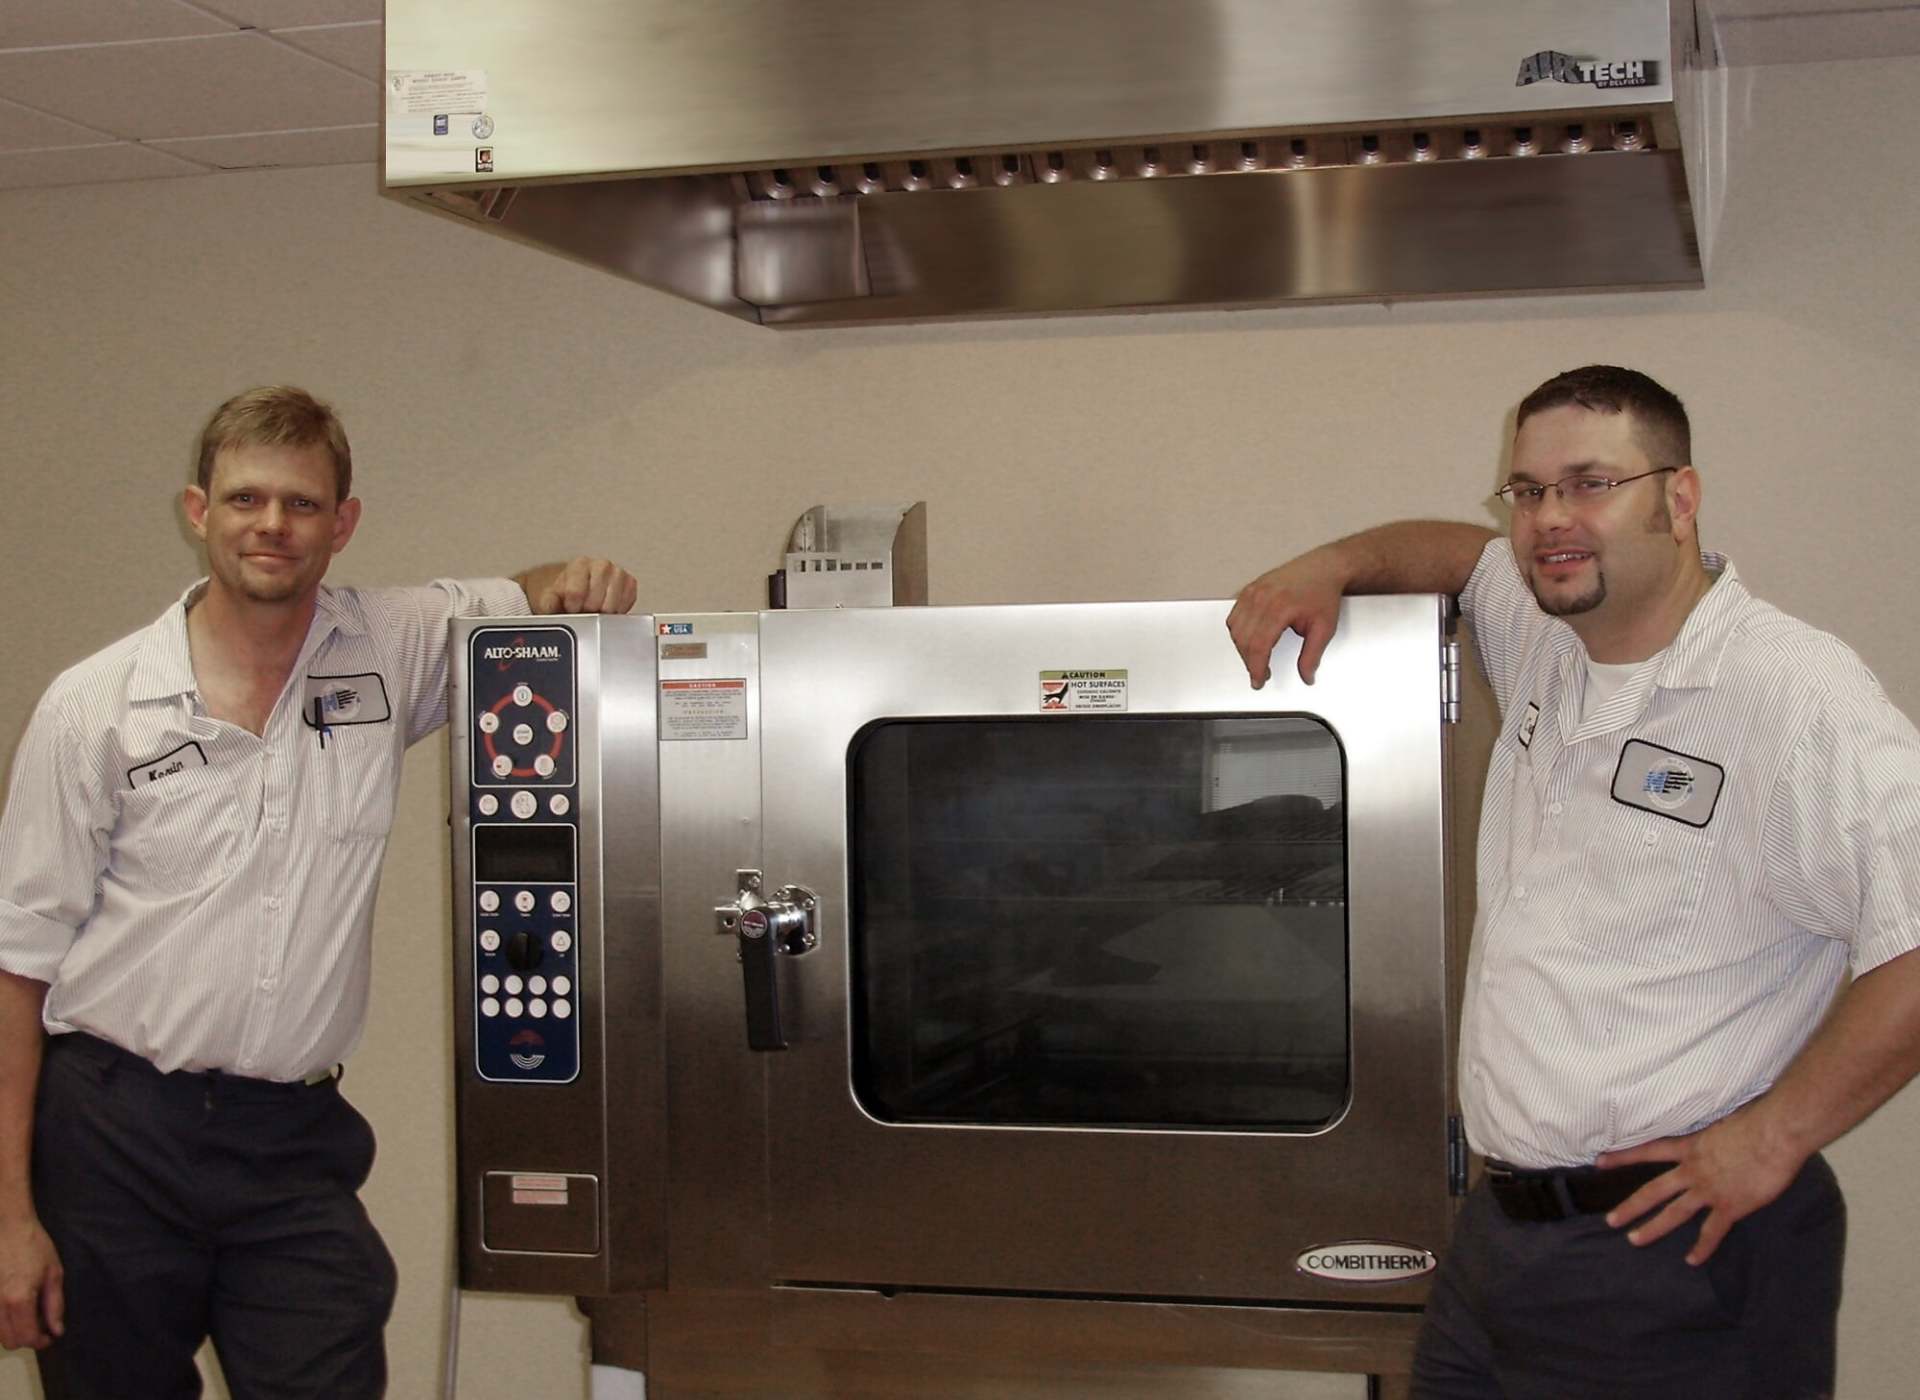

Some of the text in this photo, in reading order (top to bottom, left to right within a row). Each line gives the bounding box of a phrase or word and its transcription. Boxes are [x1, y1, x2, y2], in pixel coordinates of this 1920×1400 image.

[484, 646, 558, 659] ALTO-SHAAM
[1070, 671, 1106, 679] CAUTION
[1307, 1255, 1427, 1270] COMBITHERM
